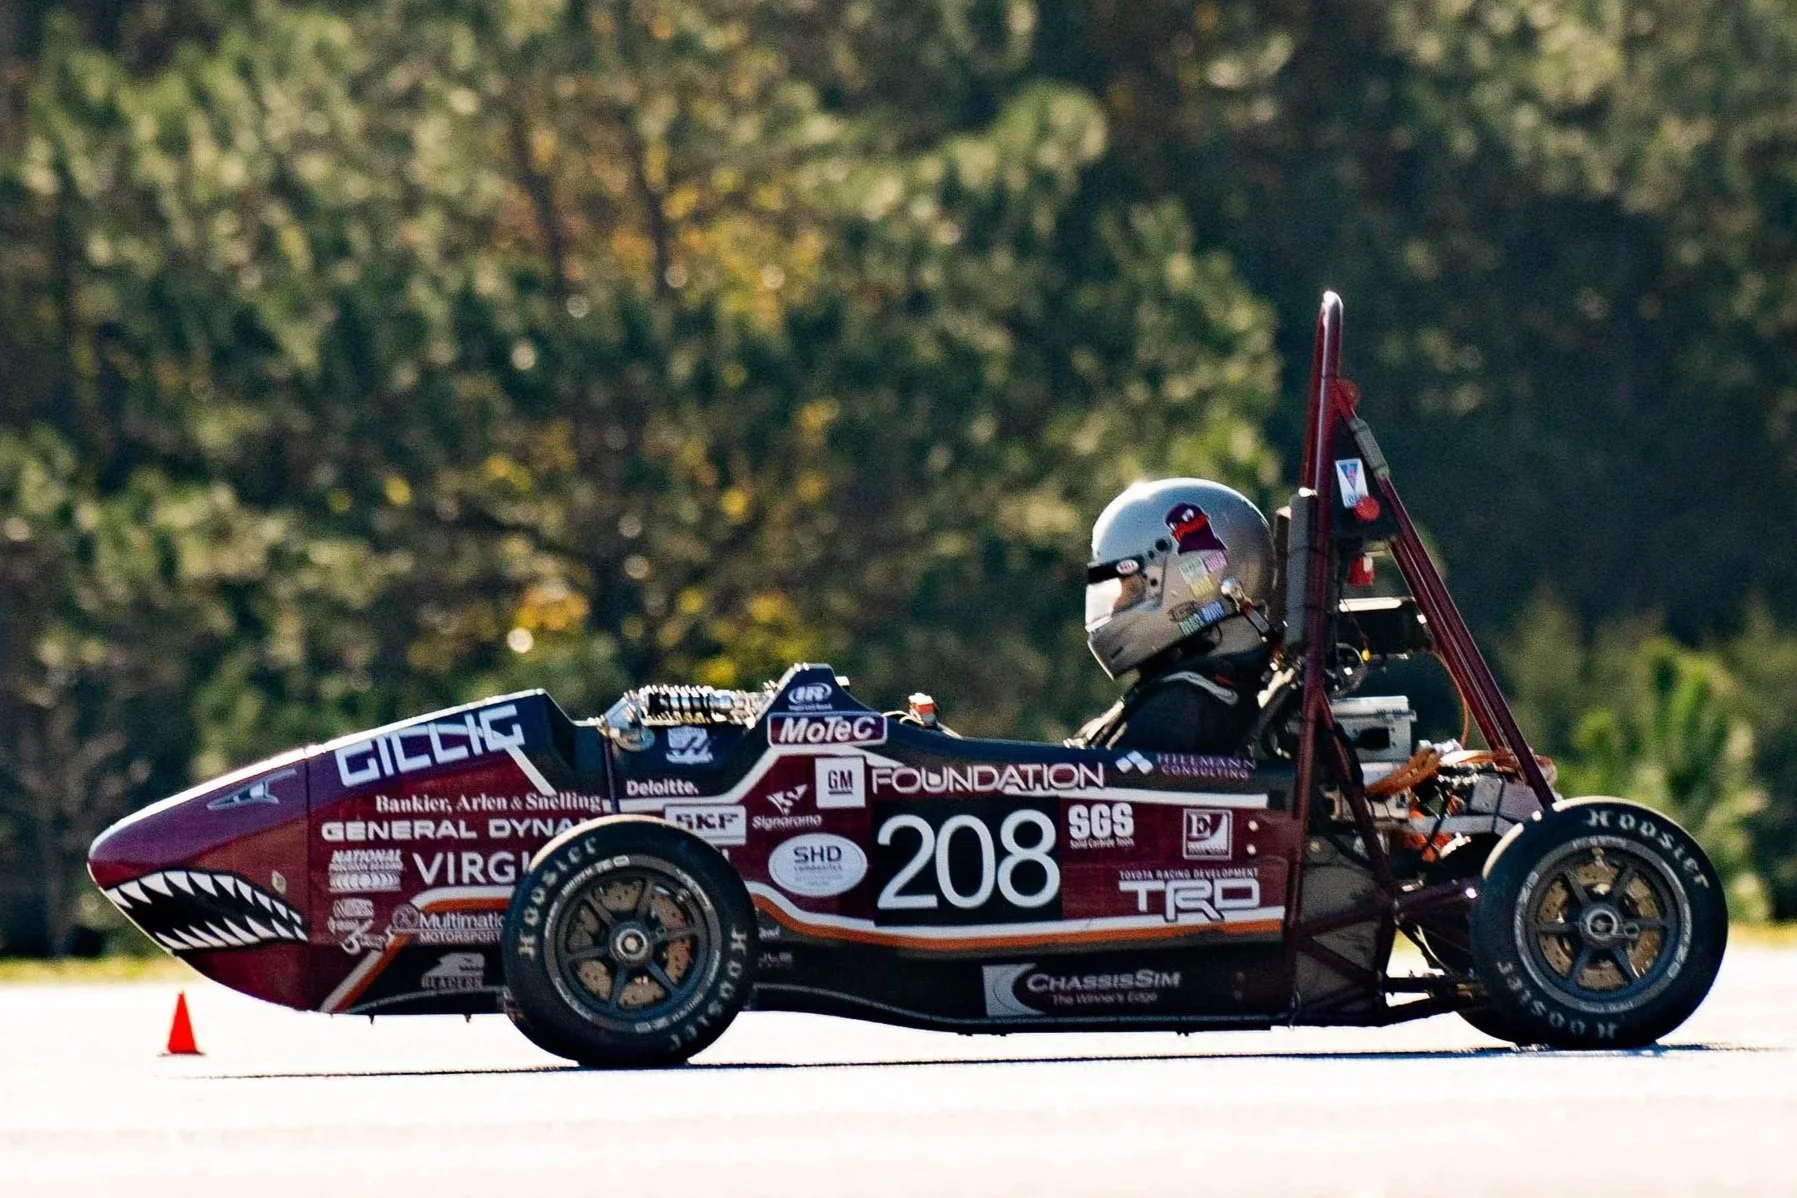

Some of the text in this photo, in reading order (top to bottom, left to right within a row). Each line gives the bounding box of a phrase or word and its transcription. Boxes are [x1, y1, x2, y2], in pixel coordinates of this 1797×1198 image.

[779, 716, 876, 743] MoTeC
[335, 704, 525, 787] GILLIG
[626, 778, 700, 796] Deloitte.
[828, 762, 1104, 794] GM FOUNDATION
[375, 791, 603, 815] Bankier, Arlen & Snelling
[321, 818, 590, 841] GENERAL DYNA
[675, 813, 739, 830] SKF
[1068, 802, 1135, 840] SGS
[793, 845, 842, 863] SHD
[877, 808, 1061, 910] 208
[412, 851, 530, 885] VIRGI
[1119, 867, 1259, 880] TOYOTA RACING DEVELOPMENT
[1119, 878, 1260, 920] TRD
[420, 911, 505, 930] Multimatic
[420, 930, 502, 943] MOTORSPORT
